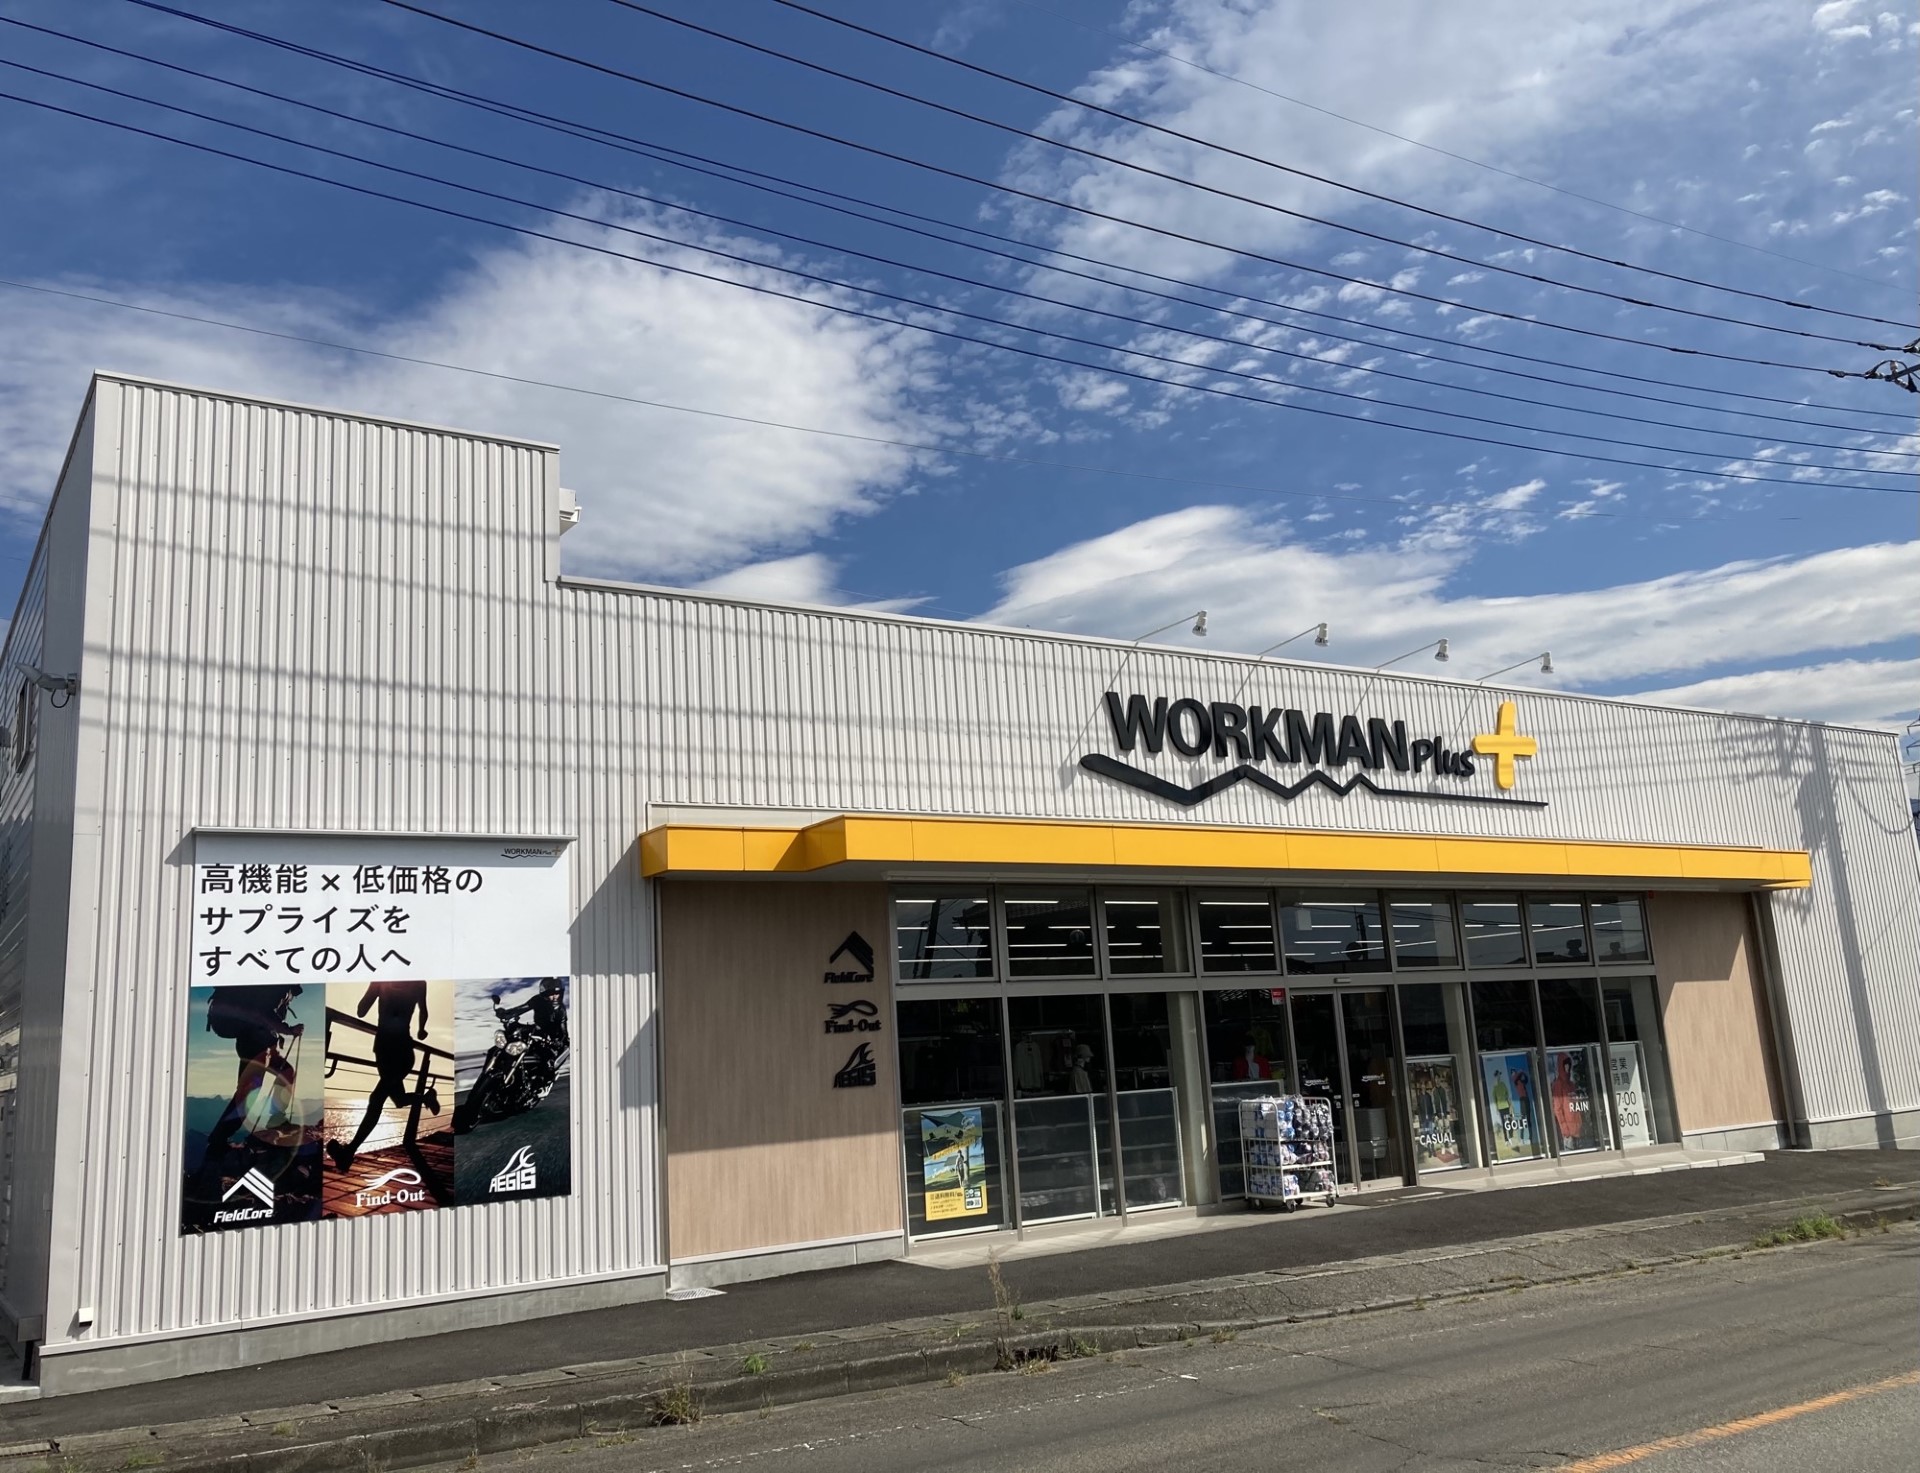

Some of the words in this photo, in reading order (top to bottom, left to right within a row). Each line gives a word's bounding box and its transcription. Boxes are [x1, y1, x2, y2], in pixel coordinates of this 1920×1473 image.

[1105, 691, 1411, 771] WORKMAN
[1410, 735, 1476, 778] Plus
[200, 903, 411, 936] サプライズを
[199, 943, 412, 976] すべての人へ
[824, 1019, 882, 1034] Find-Out
[1569, 1101, 1589, 1113] RAIN
[1615, 1091, 1637, 1107] 7:00
[1504, 1118, 1528, 1131] GOLF
[1419, 1131, 1456, 1146] CASUAL
[488, 1166, 537, 1193] AEGIS
[355, 1189, 426, 1208] Find-Out
[213, 1207, 274, 1224] FieldCore
